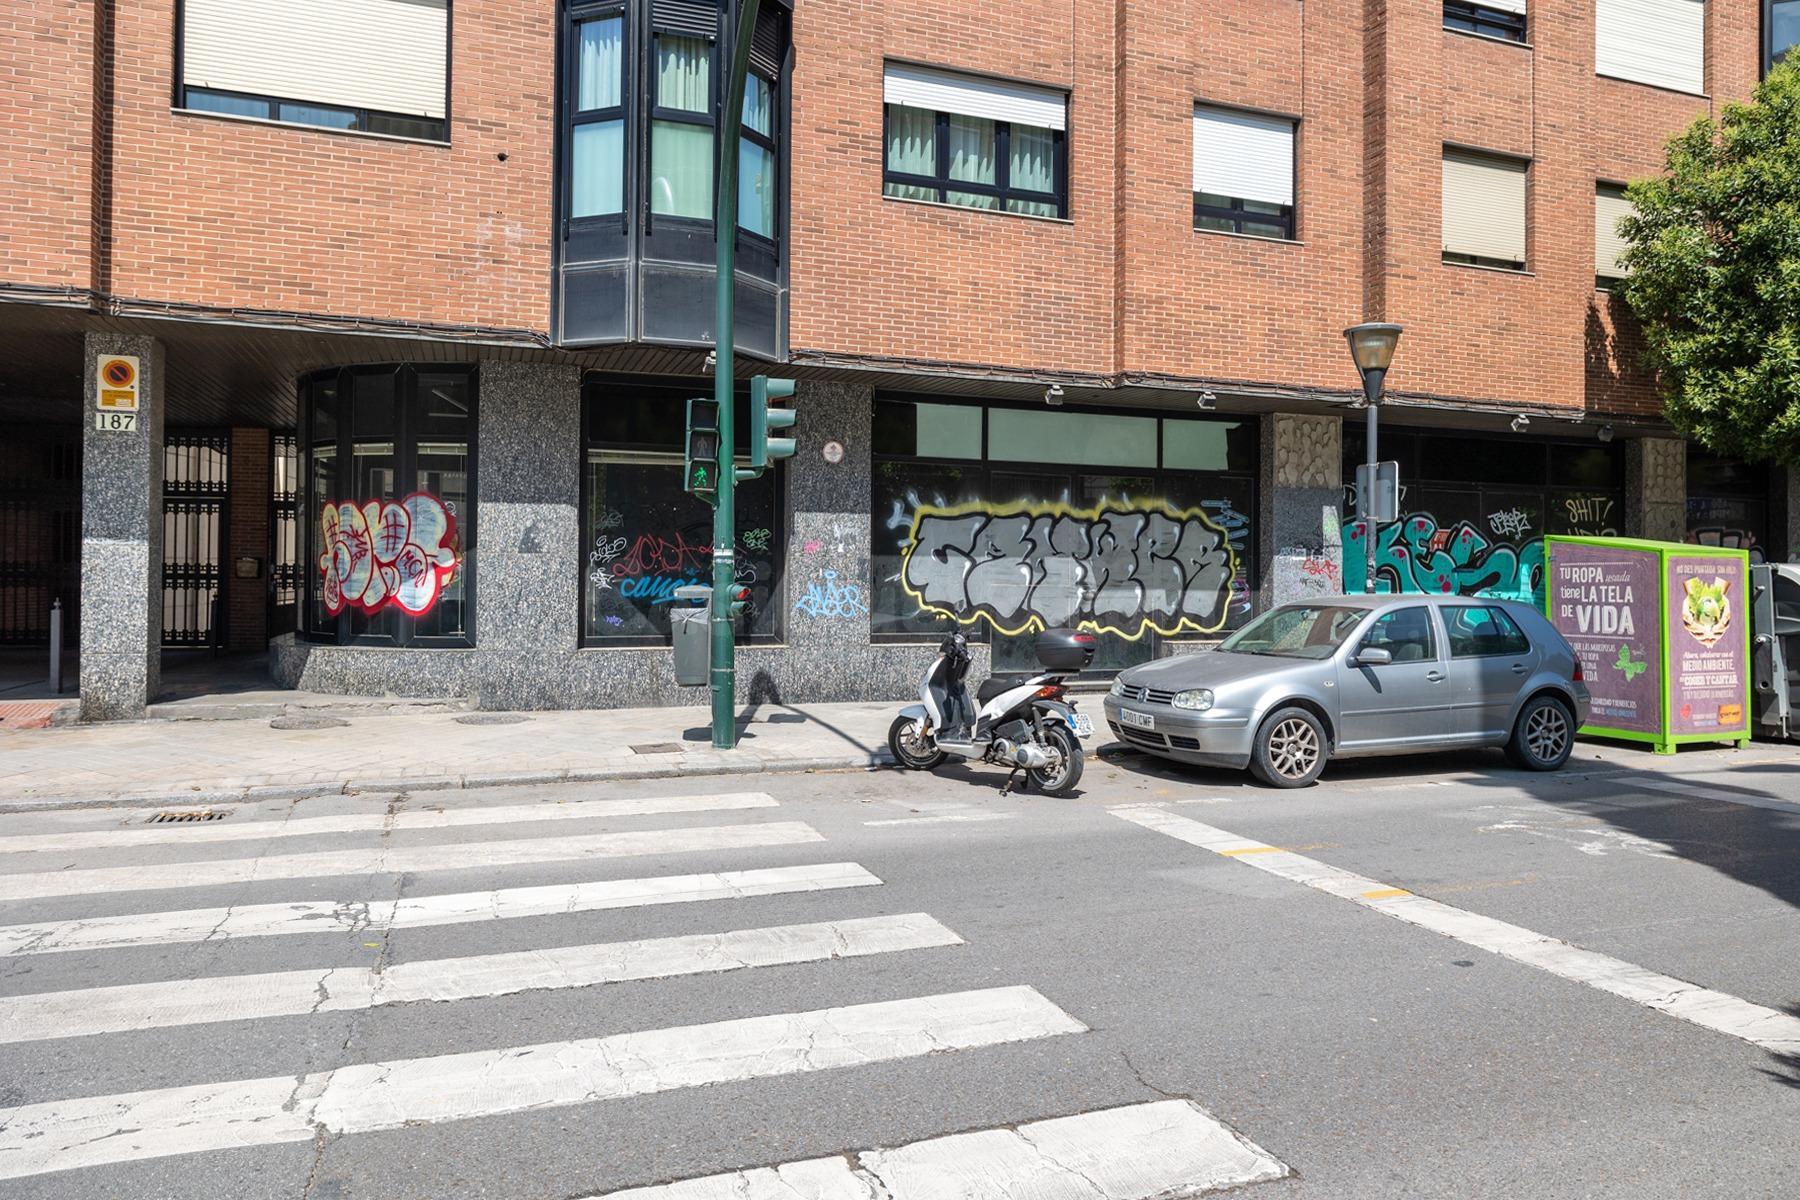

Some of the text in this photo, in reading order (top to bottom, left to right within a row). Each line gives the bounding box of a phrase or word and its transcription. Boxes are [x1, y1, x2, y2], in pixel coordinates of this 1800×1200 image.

[100, 414, 135, 430] 187
[1560, 567, 1571, 580] TU
[1572, 567, 1604, 583] ROPA
[1560, 586, 1634, 603] tiene LA TELA
[1561, 604, 1635, 635] DE VIDA
